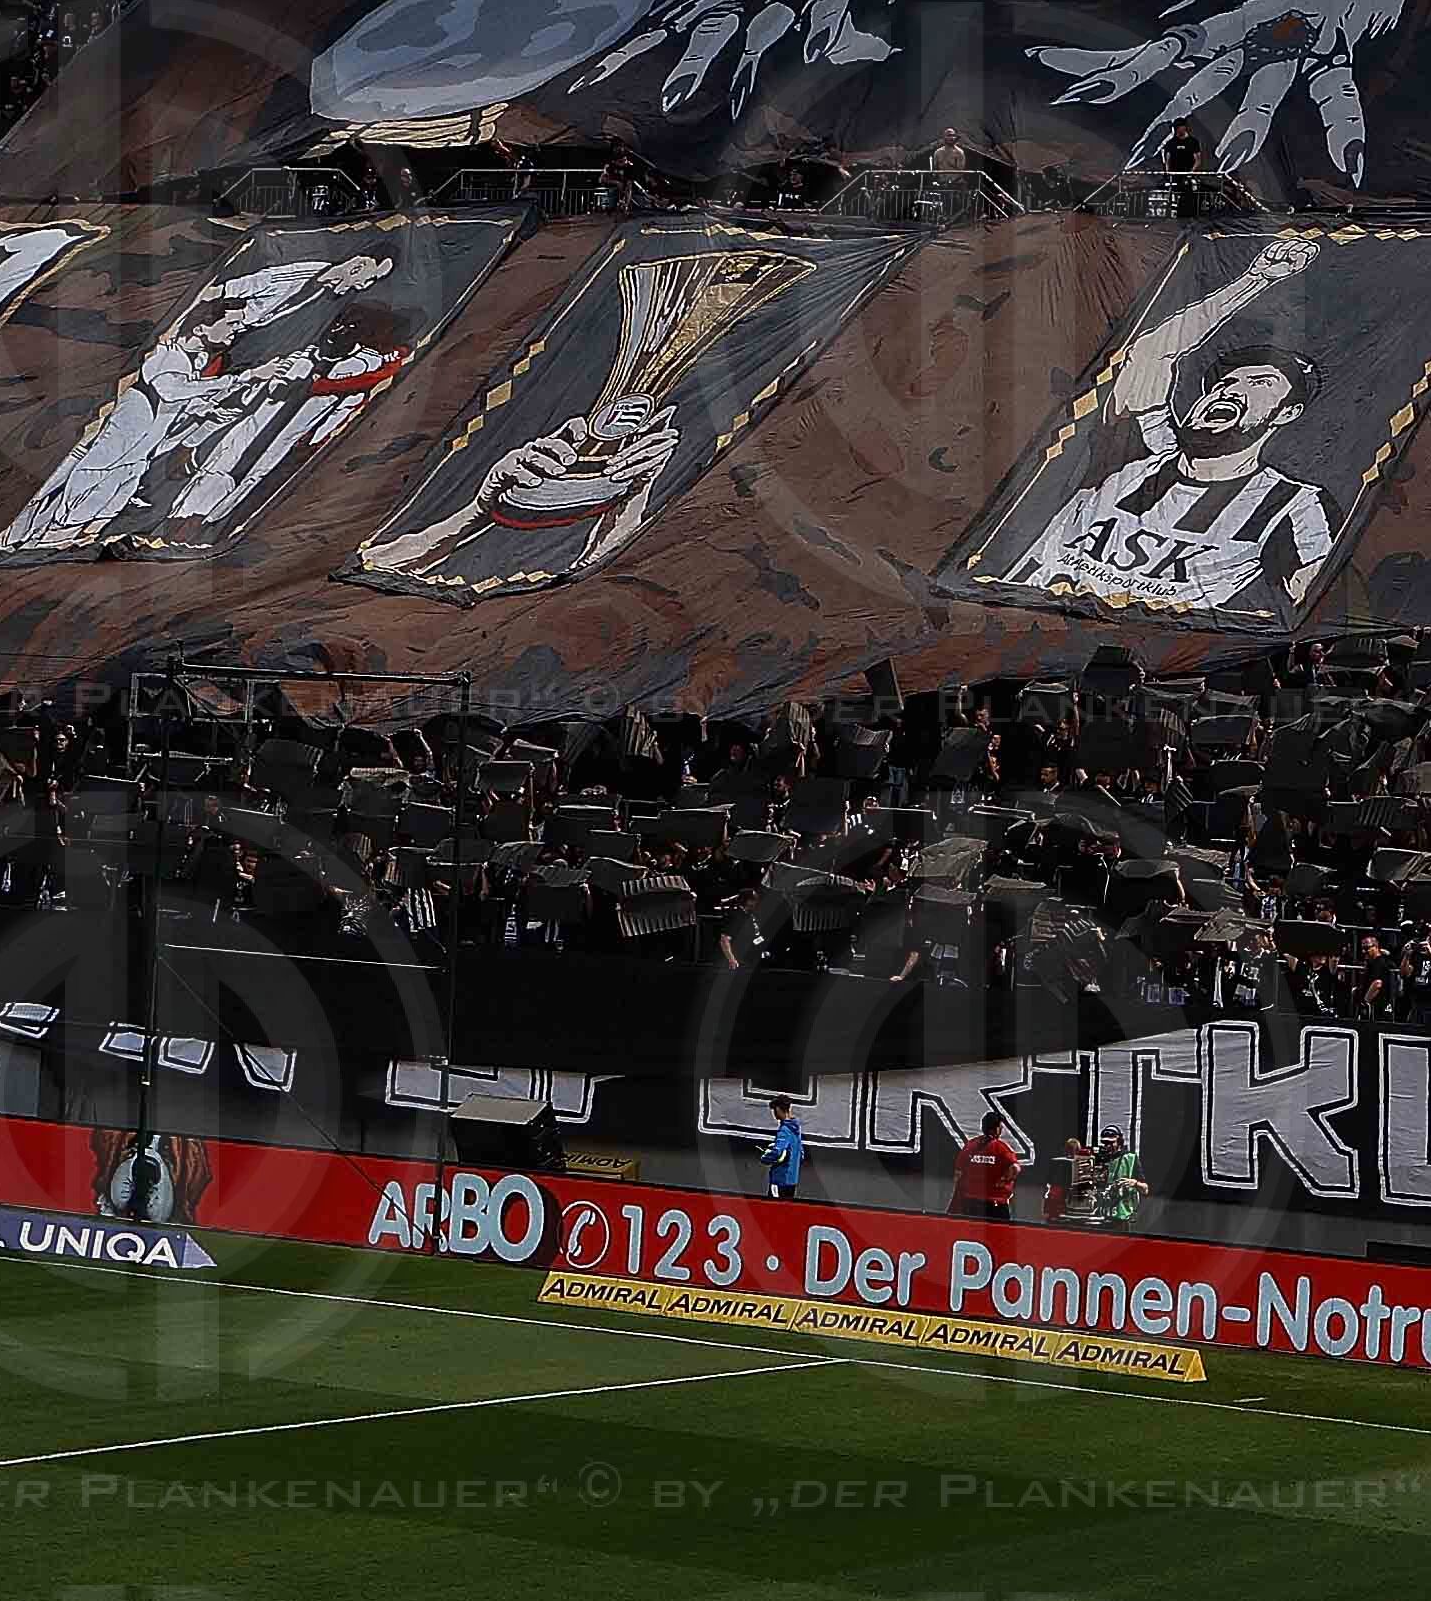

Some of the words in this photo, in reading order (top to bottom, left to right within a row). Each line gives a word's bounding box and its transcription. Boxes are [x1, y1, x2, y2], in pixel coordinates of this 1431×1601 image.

[18, 1219, 181, 1270] UNIQA
[368, 1172, 546, 1263] ARBO
[620, 1204, 744, 1288] 123
[803, 1223, 927, 1311] Der
[541, 1278, 663, 1311] ADMIRAL
[667, 1293, 789, 1325] ADMIRAL
[797, 1307, 919, 1343] ADMIRAL
[926, 1323, 1050, 1358] ADMIRAL
[1055, 1339, 1186, 1376] ADMIRAL
